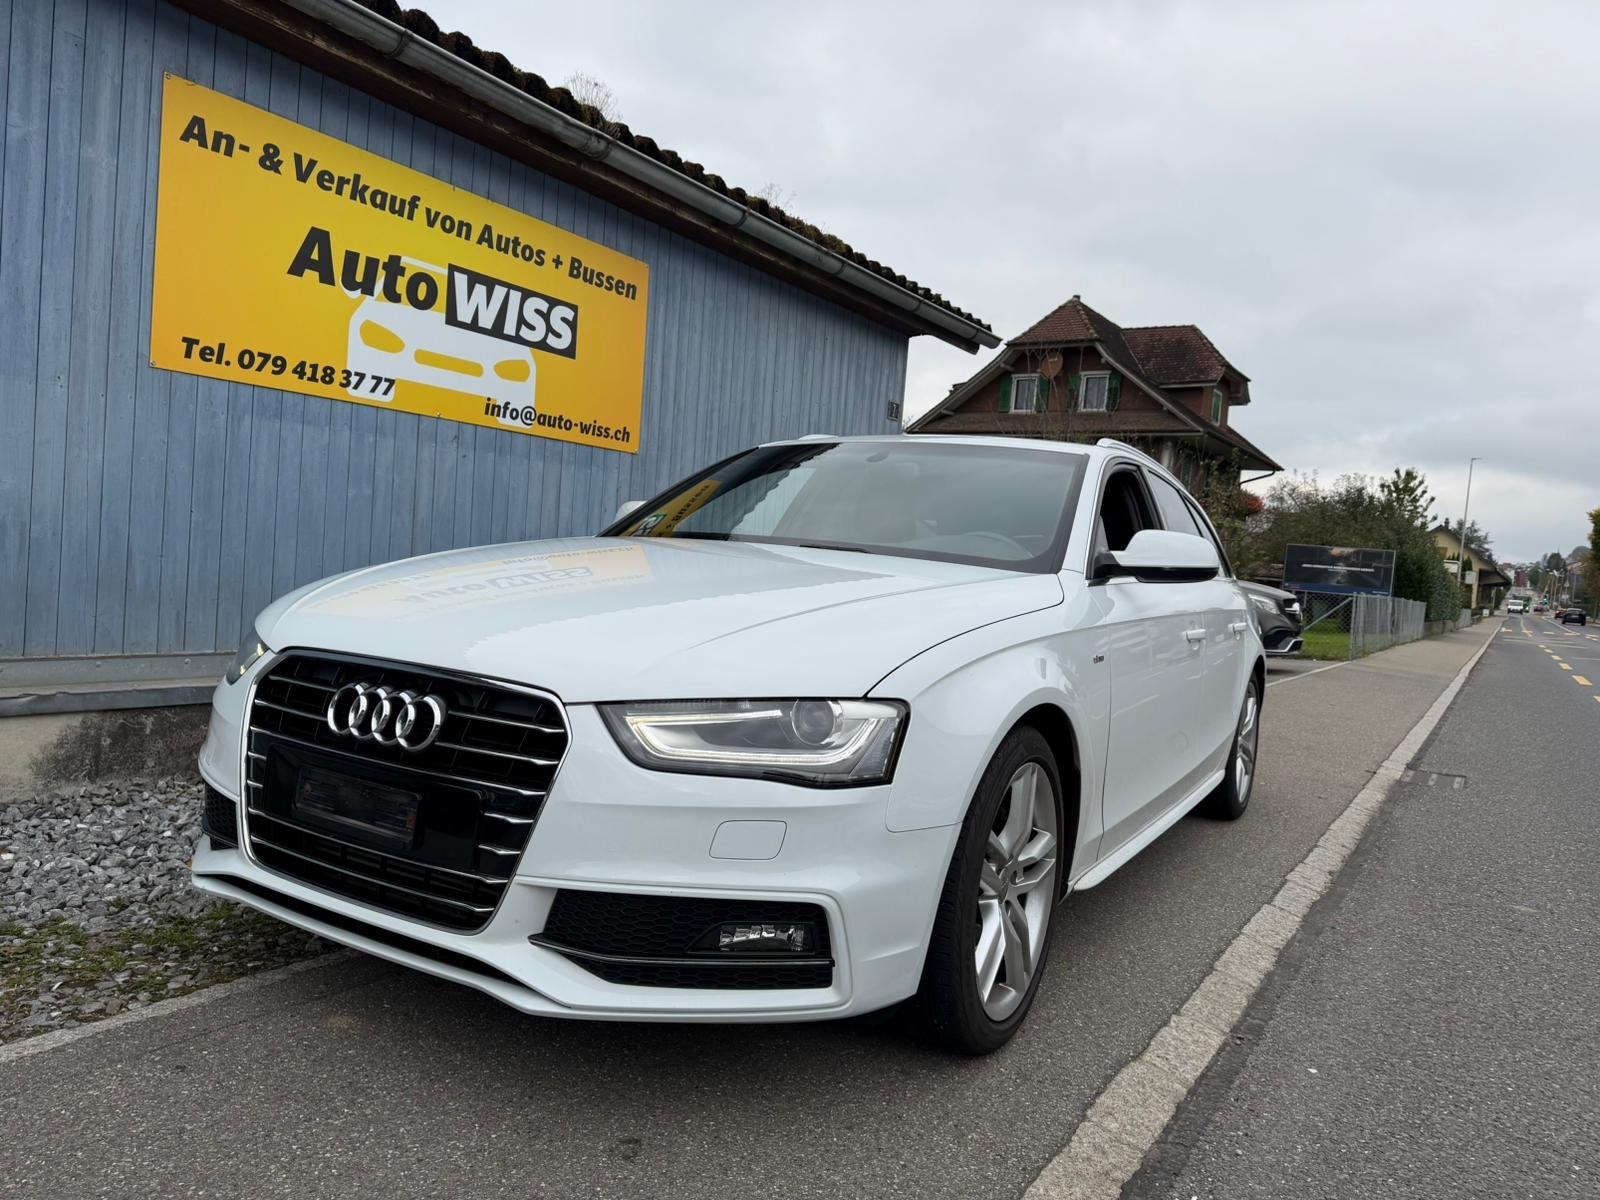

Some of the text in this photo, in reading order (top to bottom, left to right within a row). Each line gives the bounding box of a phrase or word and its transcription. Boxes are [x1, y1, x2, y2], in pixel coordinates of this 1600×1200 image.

[179, 114, 638, 301] An- & Verkauf von Autos + Bussen
[286, 225, 575, 351] Auto WISS
[181, 336, 396, 397] Tel. 079 418 37 77
[484, 397, 632, 444] info@auto-wiss.ch
